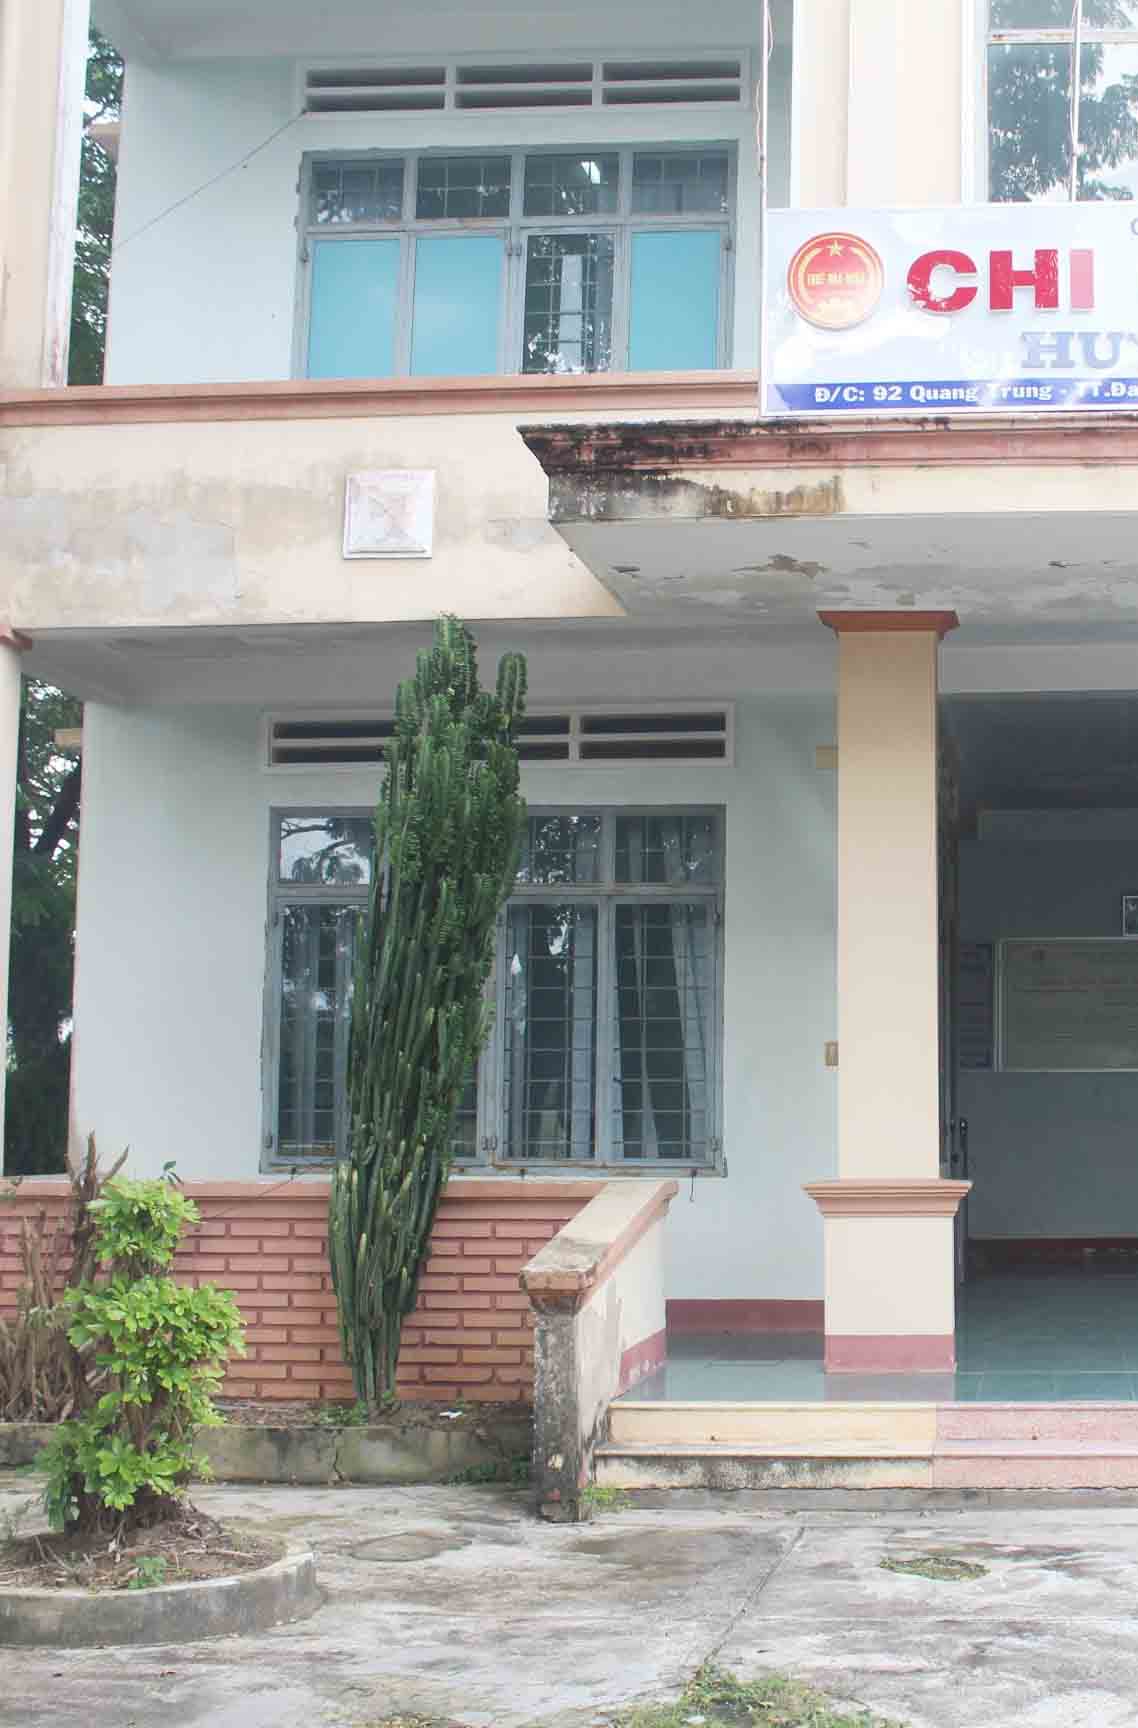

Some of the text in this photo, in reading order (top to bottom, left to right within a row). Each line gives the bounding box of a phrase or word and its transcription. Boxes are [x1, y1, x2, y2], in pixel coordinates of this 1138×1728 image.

[905, 248, 1095, 314] CHI
[814, 385, 866, 404] Đ/C:
[872, 384, 903, 402] 92
[909, 382, 979, 404] Quang
[986, 380, 1053, 402] Trung
